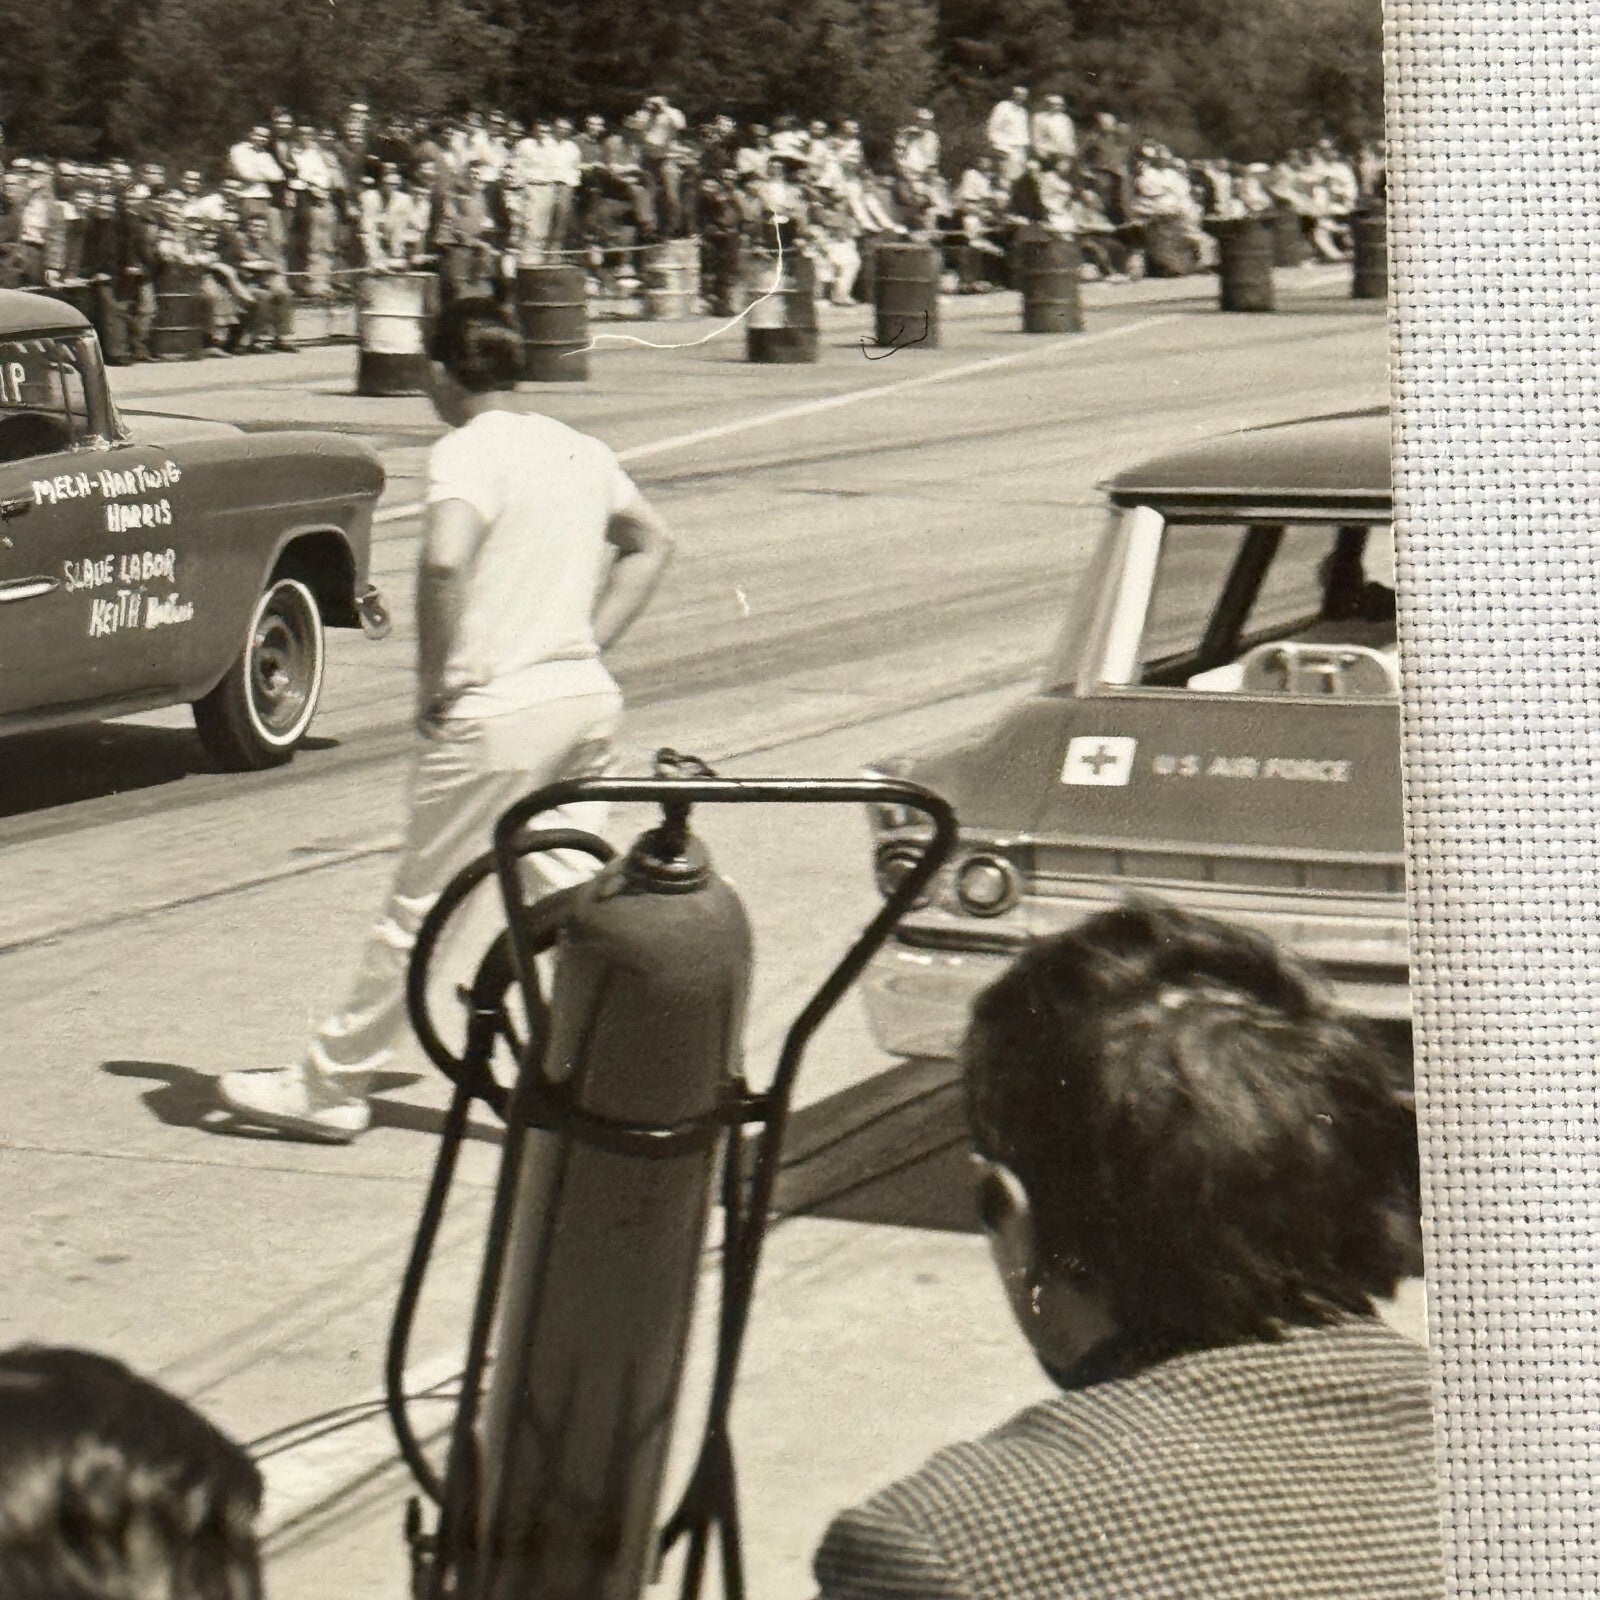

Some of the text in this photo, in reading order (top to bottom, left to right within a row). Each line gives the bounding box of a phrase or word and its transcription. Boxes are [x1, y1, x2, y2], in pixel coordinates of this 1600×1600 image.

[106, 499, 173, 532] HARRIS
[119, 548, 177, 584] LABOR
[89, 589, 142, 638] KEITH
[1205, 756, 1259, 778] AIR
[1265, 758, 1353, 782] FORCE
